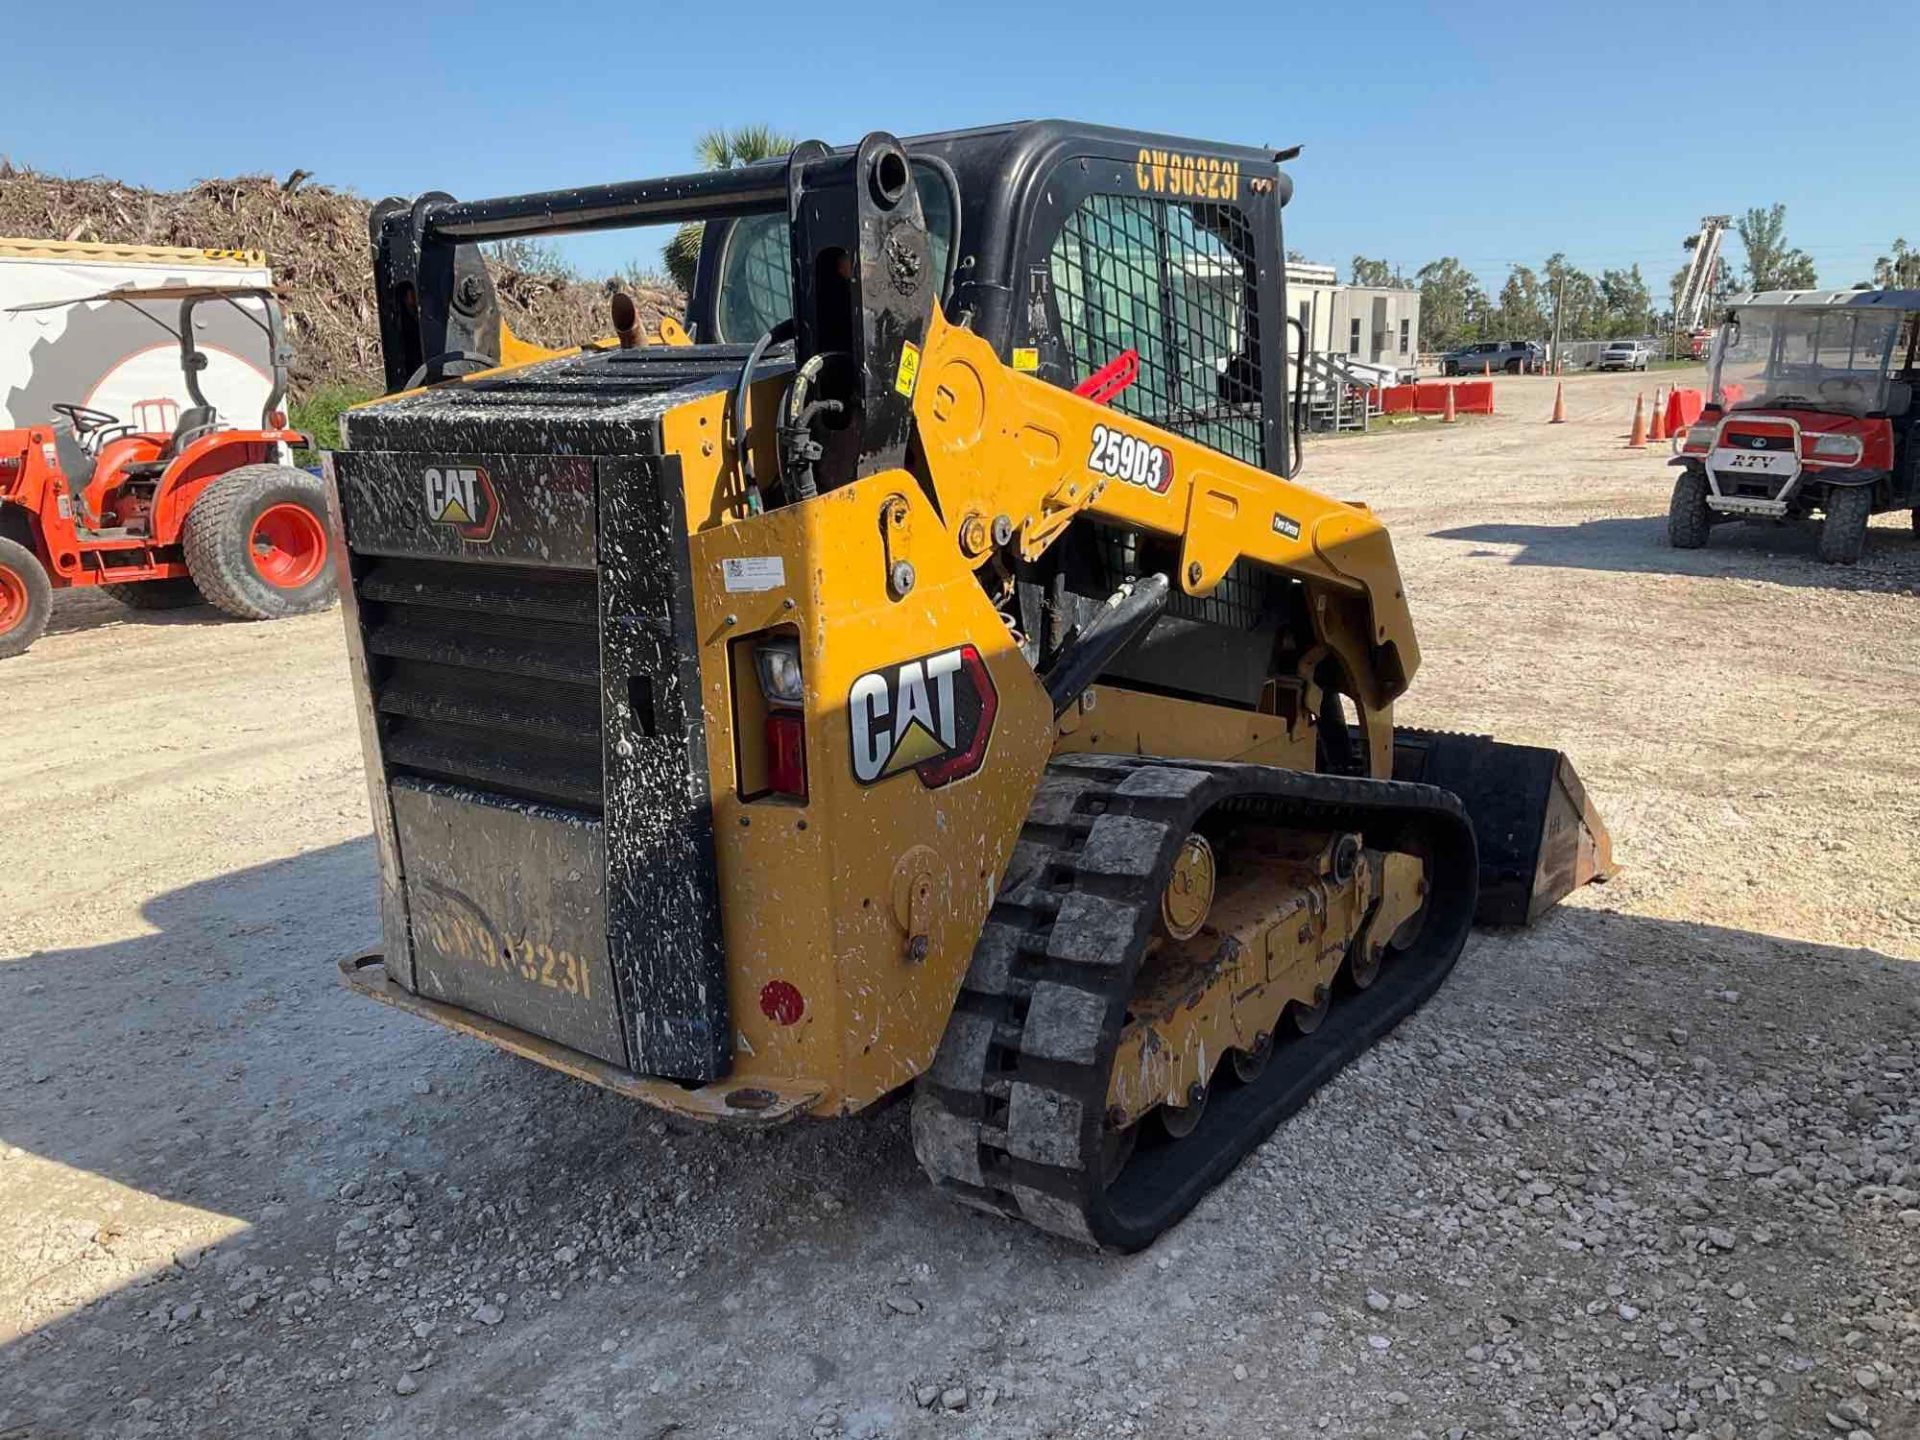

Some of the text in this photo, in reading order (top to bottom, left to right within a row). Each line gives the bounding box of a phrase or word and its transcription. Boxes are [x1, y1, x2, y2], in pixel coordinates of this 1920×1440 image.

[1089, 424, 1164, 490] 259D3
[1729, 454, 1777, 469] RTV
[425, 468, 477, 523] CAT
[850, 648, 963, 781] CAT
